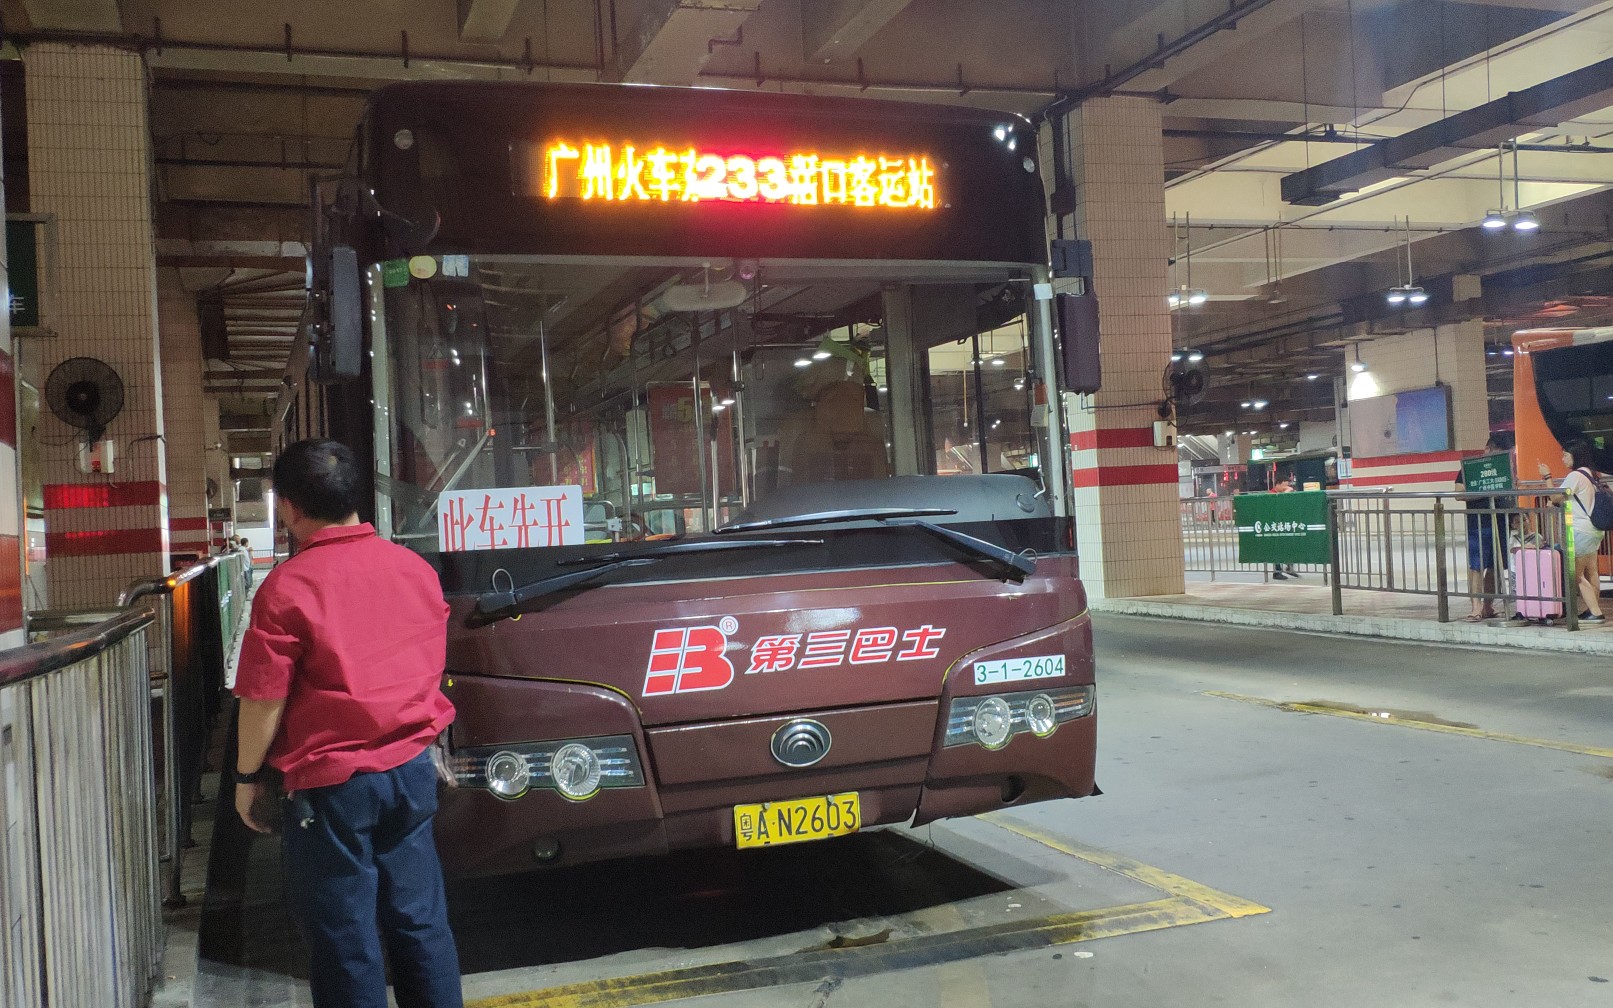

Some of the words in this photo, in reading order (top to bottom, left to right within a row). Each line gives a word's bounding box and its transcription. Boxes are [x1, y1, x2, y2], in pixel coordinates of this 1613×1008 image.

[696, 155, 788, 200] 233
[443, 492, 571, 552] 此车先开
[744, 624, 947, 675] 第三巴士
[976, 657, 1064, 683] 3-1-2604
